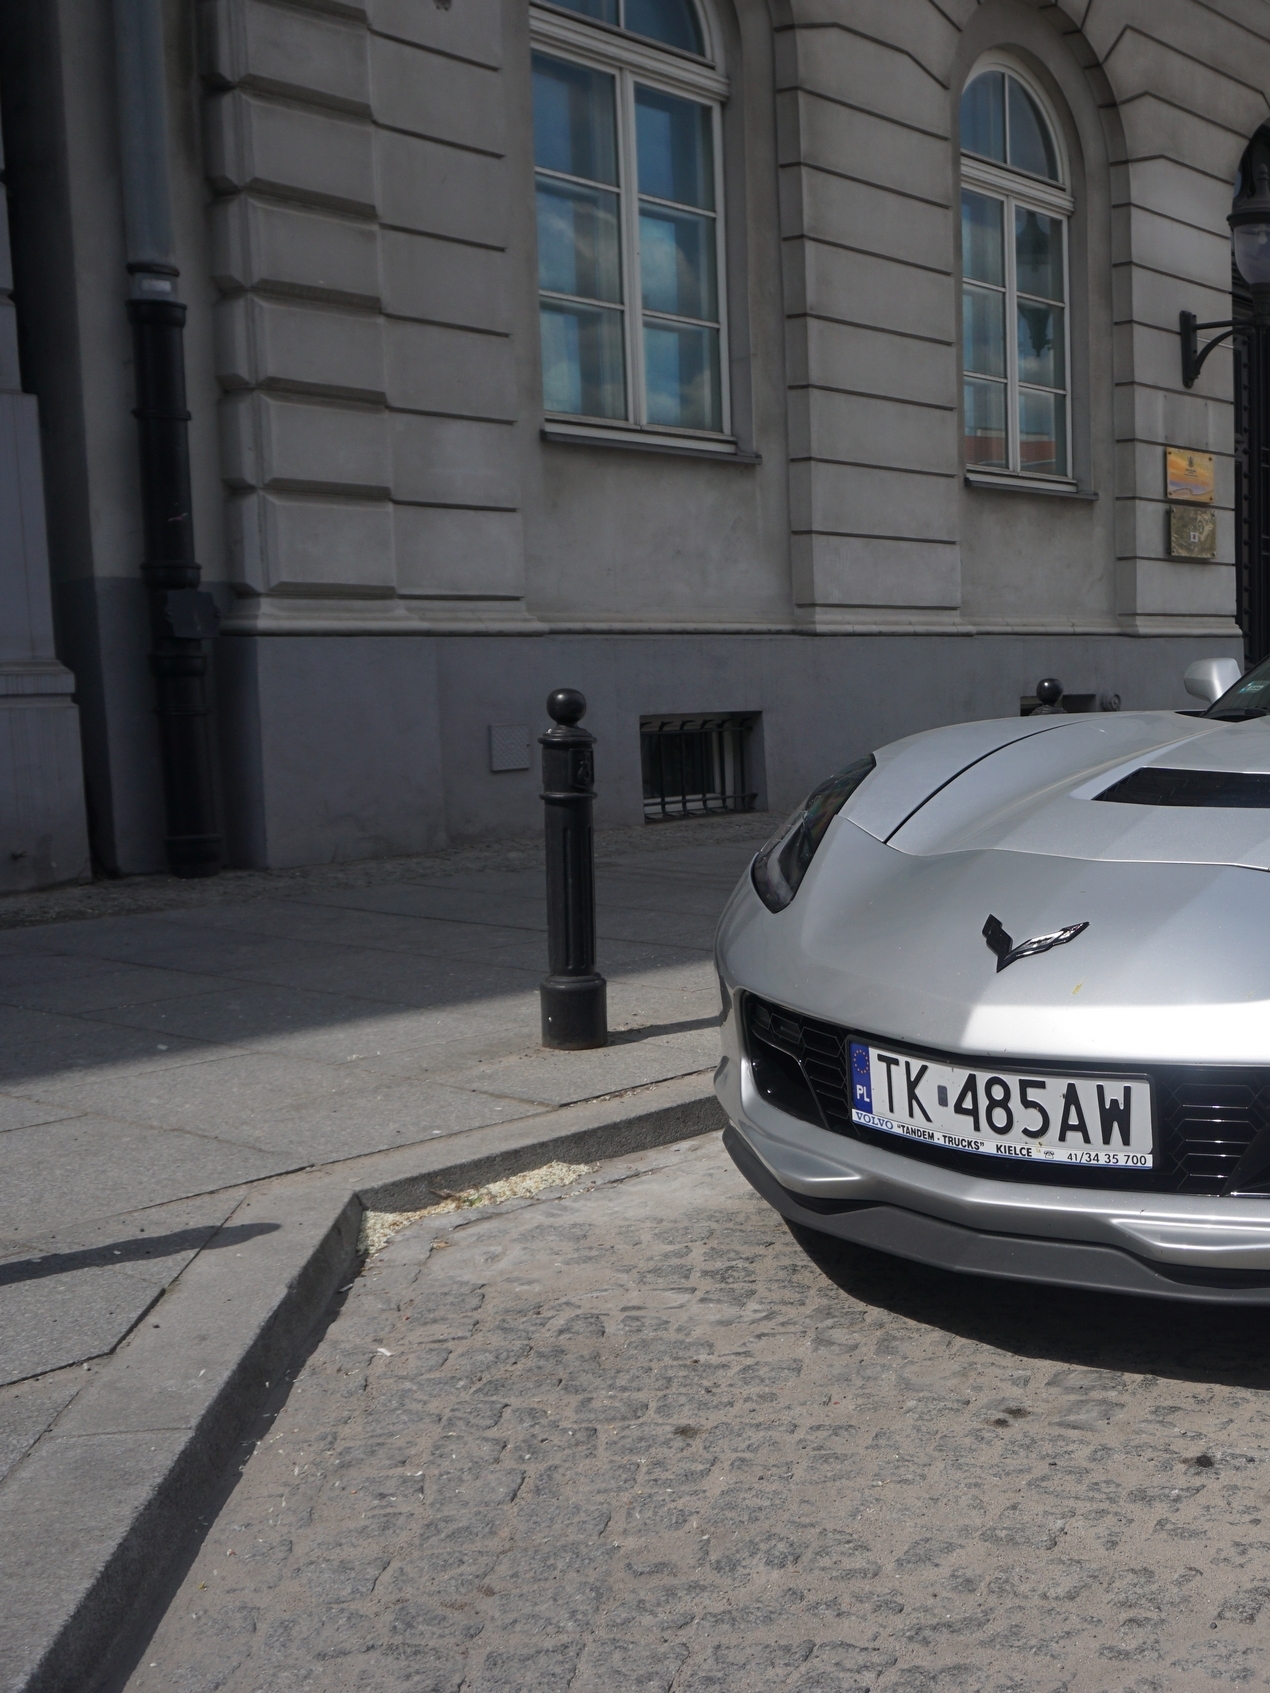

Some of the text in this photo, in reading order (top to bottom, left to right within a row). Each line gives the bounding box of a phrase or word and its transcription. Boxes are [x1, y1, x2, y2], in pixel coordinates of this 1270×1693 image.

[856, 1084, 871, 1103] PL
[877, 1053, 1132, 1147] TK 485AW
[855, 1111, 894, 1130] VOLVO
[995, 1144, 1033, 1157] KIELCE
[1067, 1151, 1100, 1164] 41/34
[1104, 1154, 1119, 1164] 35
[1124, 1155, 1147, 1166] 700
